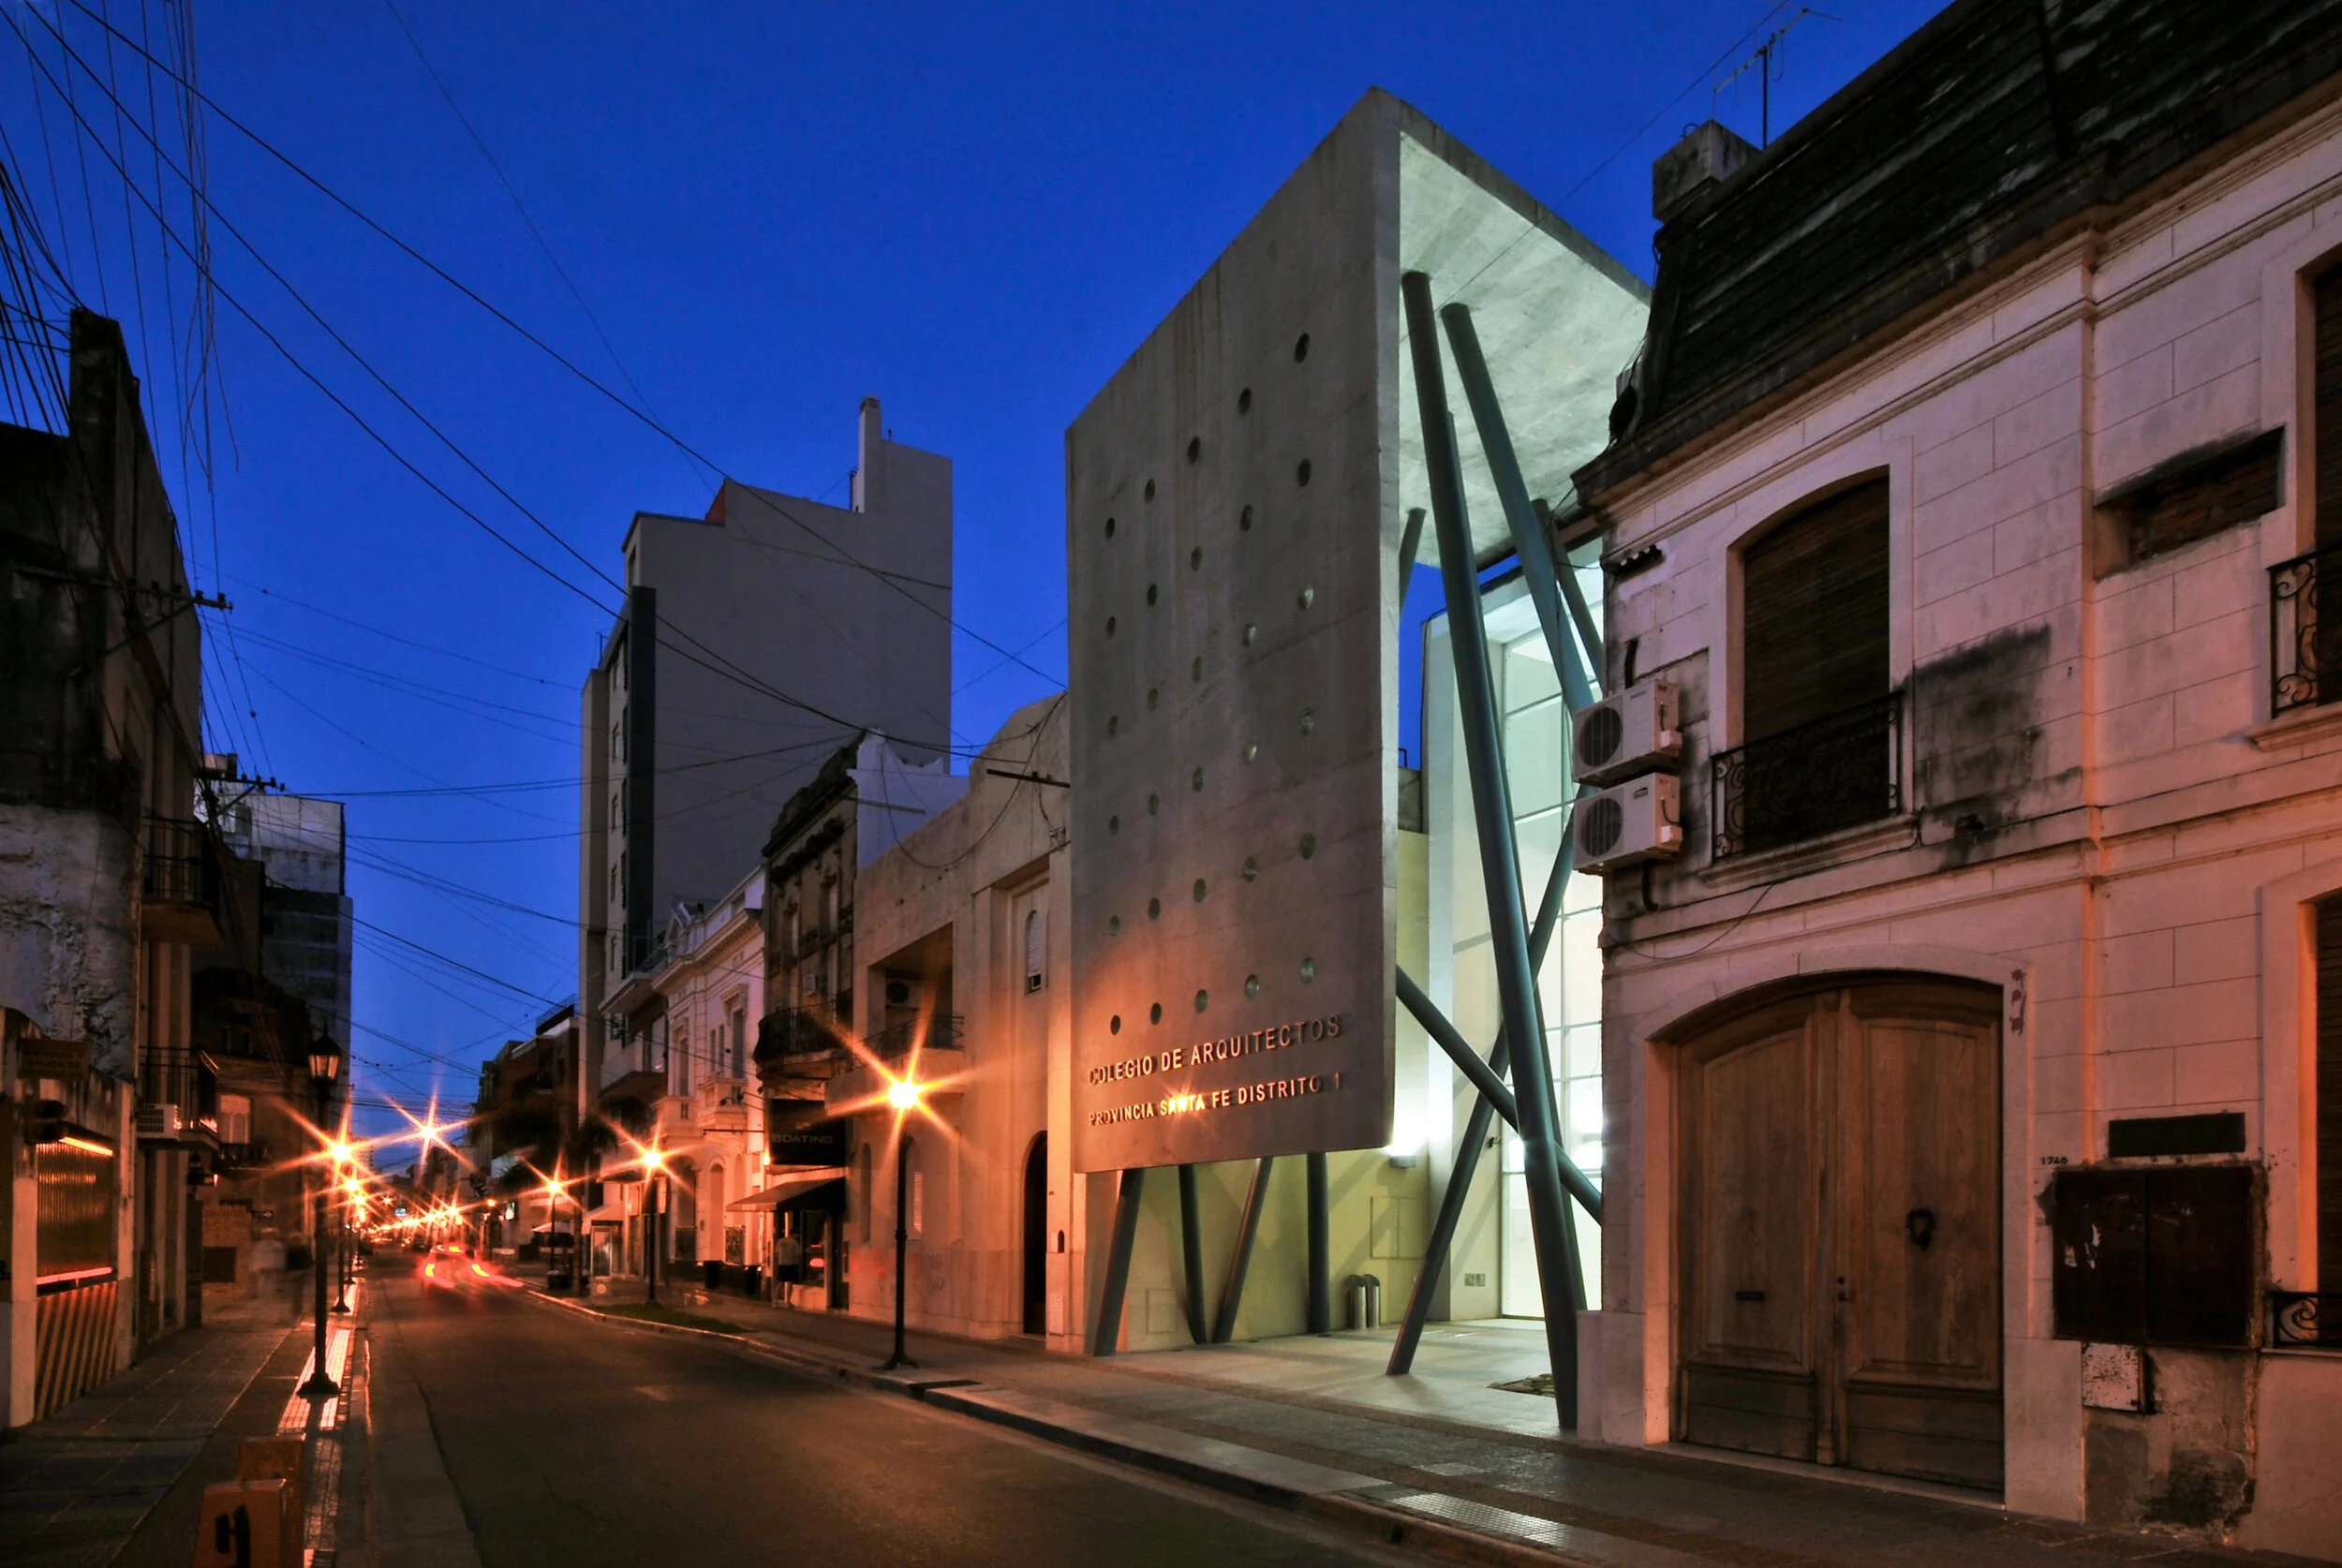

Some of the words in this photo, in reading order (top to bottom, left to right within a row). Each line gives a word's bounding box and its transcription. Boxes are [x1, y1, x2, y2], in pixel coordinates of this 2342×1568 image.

[1089, 1055, 1154, 1085] COLEGIO
[1161, 1048, 1182, 1072] DE
[1190, 1013, 1341, 1066] ARQUITECTOS
[1089, 1102, 1154, 1126] PROVINCIA
[1160, 1094, 1206, 1117] SANTA
[1212, 1089, 1230, 1109] FE
[1238, 1075, 1322, 1105] DISTRITO
[1334, 1072, 1341, 1090] 1
